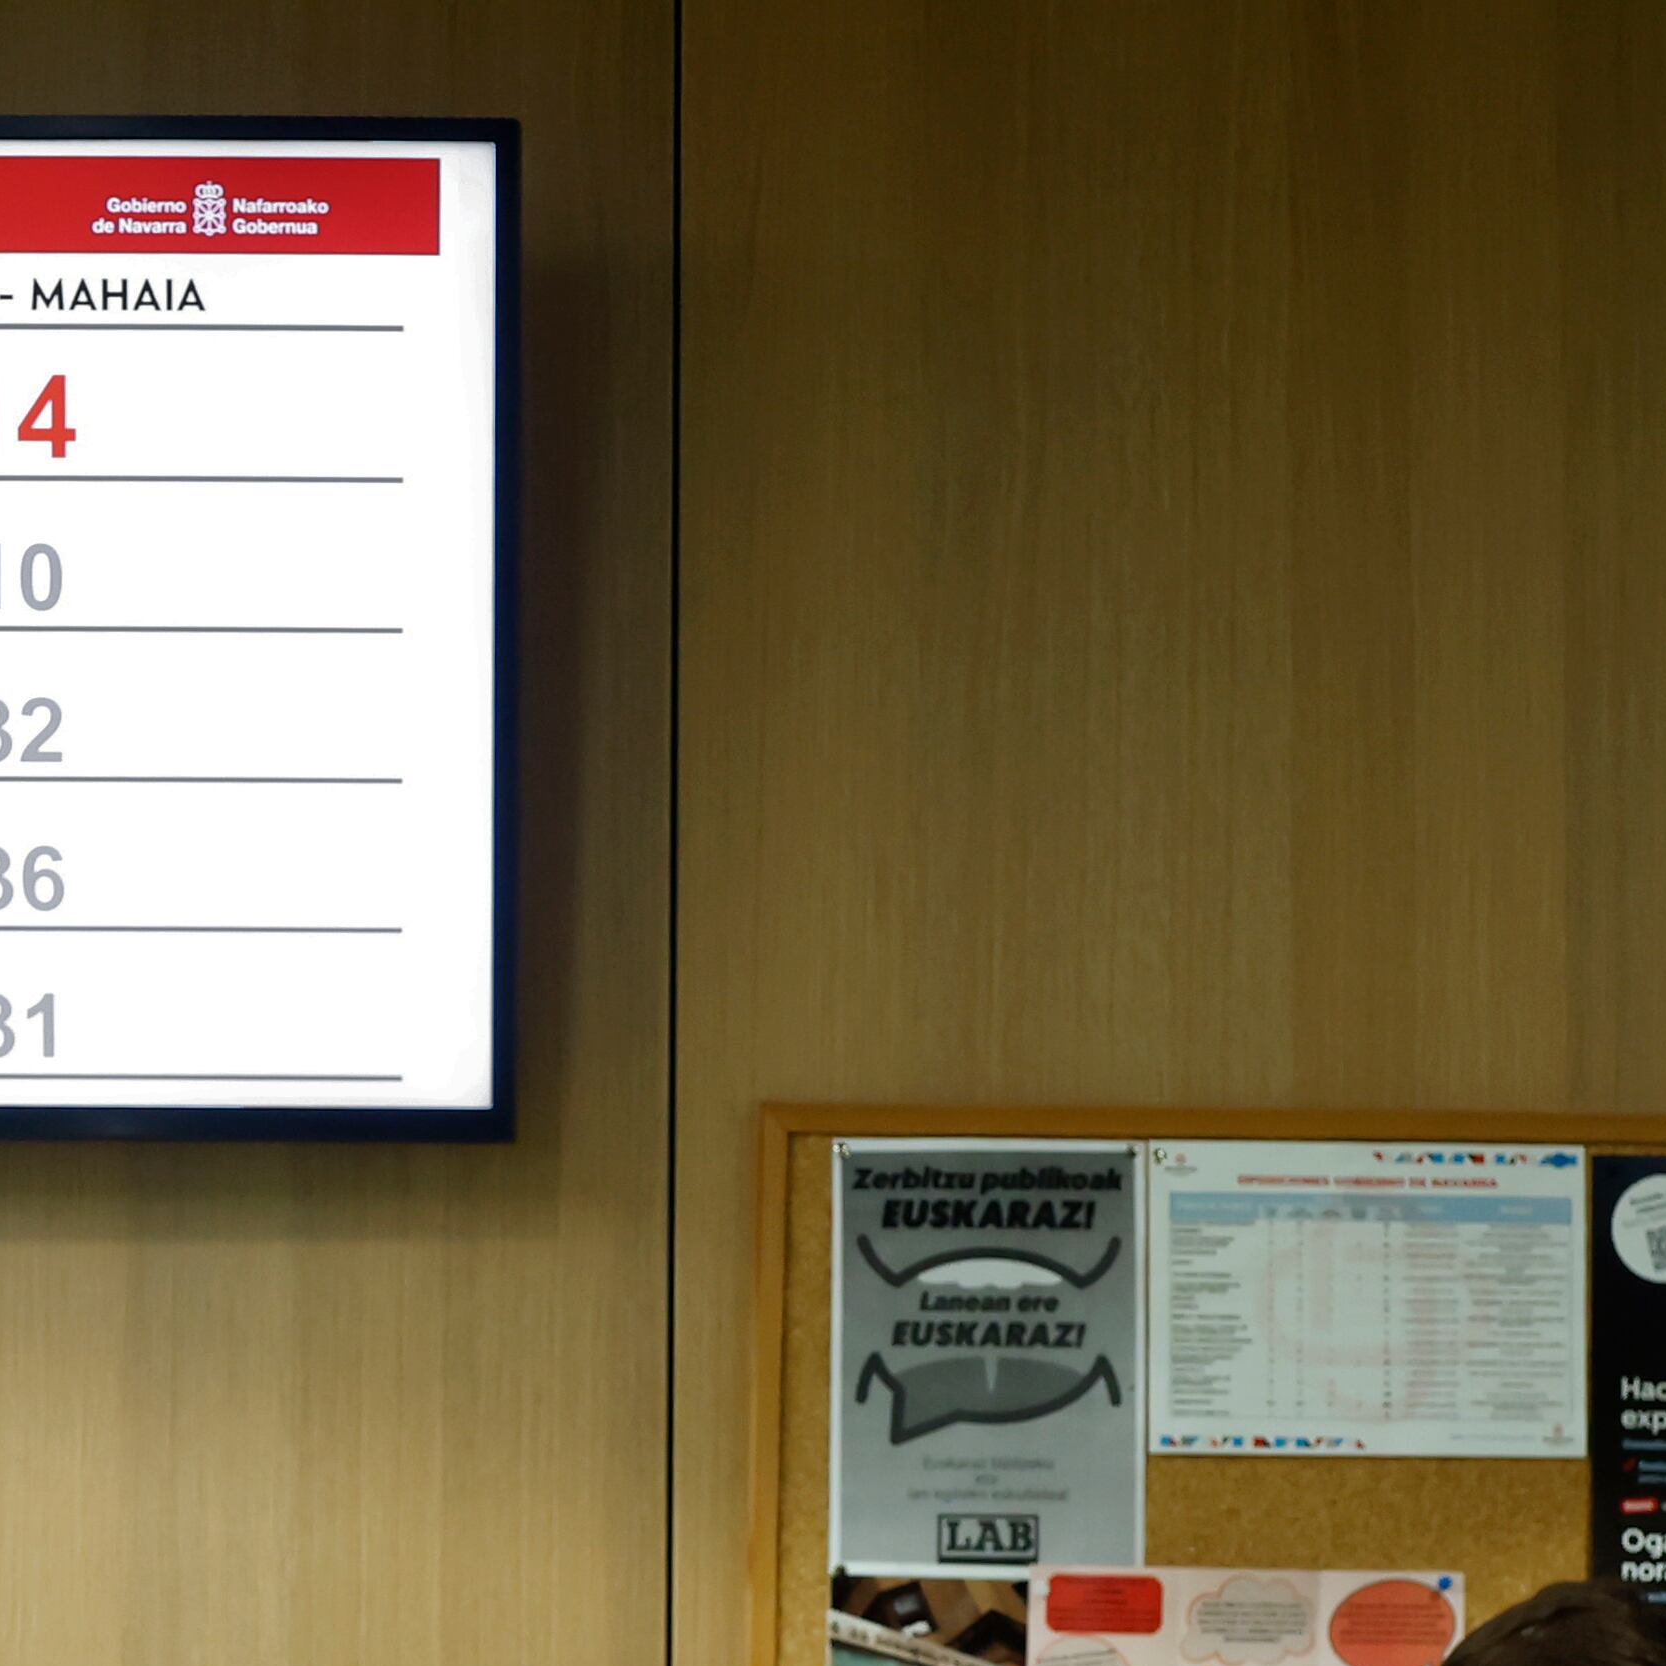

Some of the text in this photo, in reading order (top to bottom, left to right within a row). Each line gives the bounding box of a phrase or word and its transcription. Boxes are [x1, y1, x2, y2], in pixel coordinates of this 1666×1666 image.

[106, 196, 187, 215] Gobierno
[232, 197, 329, 215] Nafarroako
[92, 216, 187, 235] de Navarra
[232, 216, 318, 236] Gobernua
[31, 277, 207, 312] MAHAIA
[852, 1166, 1123, 1195] Zerbitzu publikoak
[882, 1198, 1097, 1230] EUSKARAZ!
[918, 1290, 1061, 1313] Lanean ere
[891, 1319, 1087, 1349] EUSKARAZ!
[946, 1519, 1034, 1552] LAB
